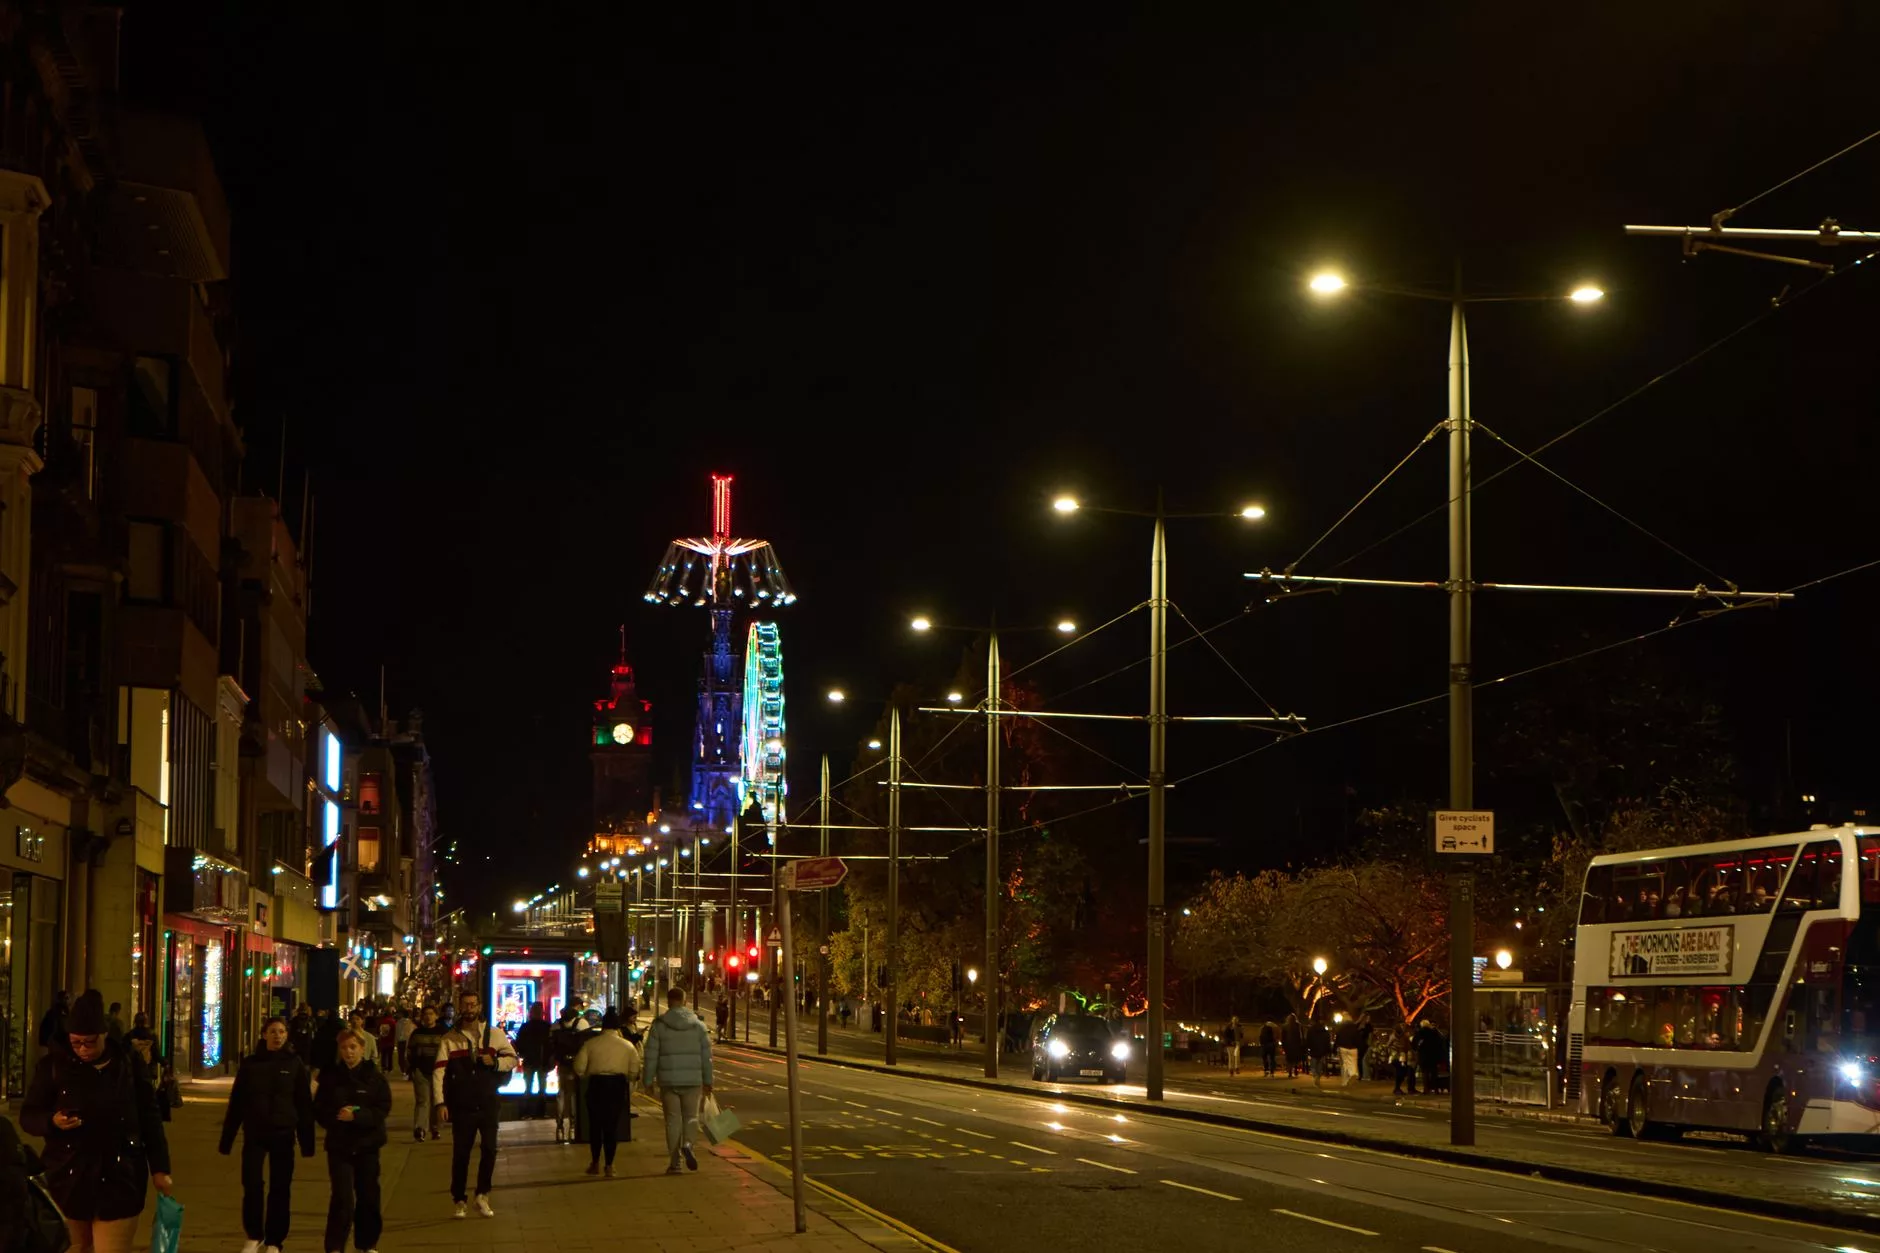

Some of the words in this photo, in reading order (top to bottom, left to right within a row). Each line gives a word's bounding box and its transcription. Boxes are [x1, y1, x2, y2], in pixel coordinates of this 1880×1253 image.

[1459, 814, 1490, 823] cyclists
[1626, 935, 1640, 952] THE
[1640, 932, 1680, 953] MORMONS
[1680, 931, 1697, 952] ARE
[1697, 930, 1721, 951] BACK!
